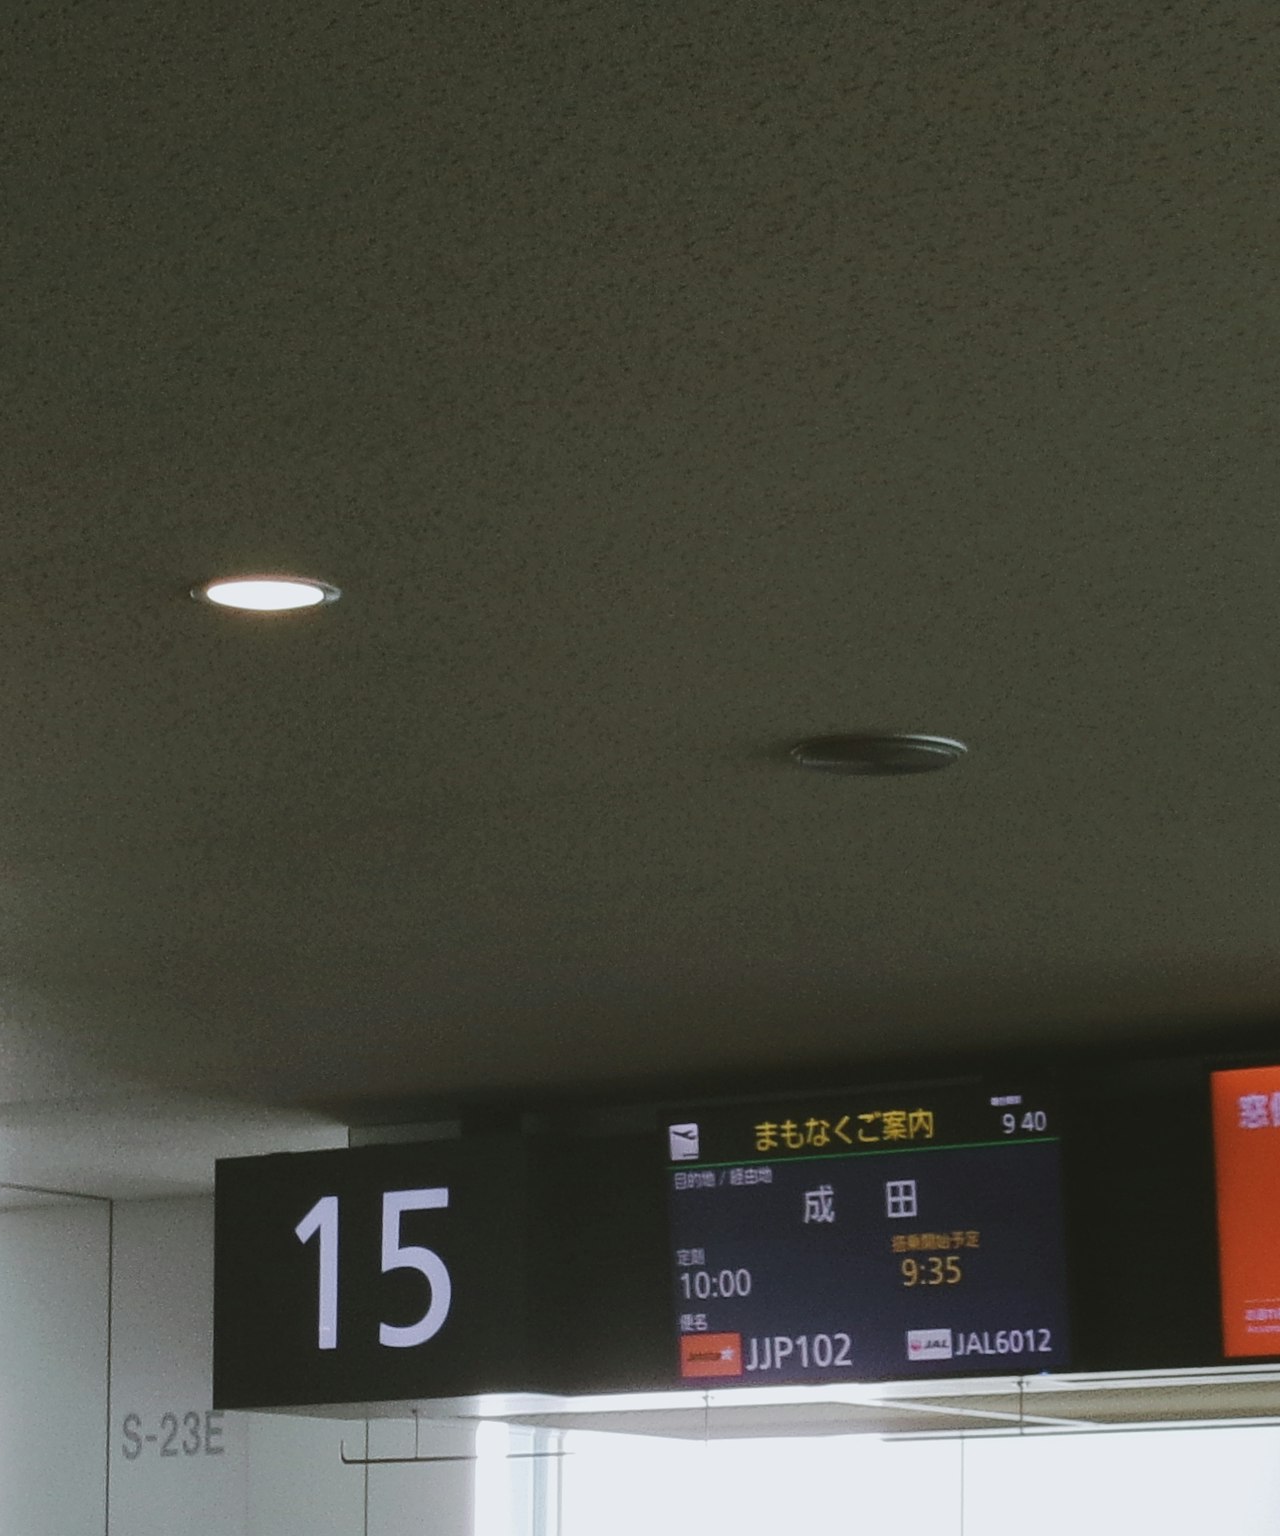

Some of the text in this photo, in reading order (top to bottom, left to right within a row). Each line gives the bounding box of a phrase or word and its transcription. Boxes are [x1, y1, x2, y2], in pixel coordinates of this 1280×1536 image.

[753, 1108, 934, 1152] まもなくご案内
[294, 1186, 453, 1352] 15
[680, 1268, 752, 1300] 10:00
[901, 1256, 963, 1287] 9:35
[745, 1332, 853, 1371] JJP102
[954, 1328, 1053, 1356] JAL6012
[121, 1410, 225, 1460] S-23E
